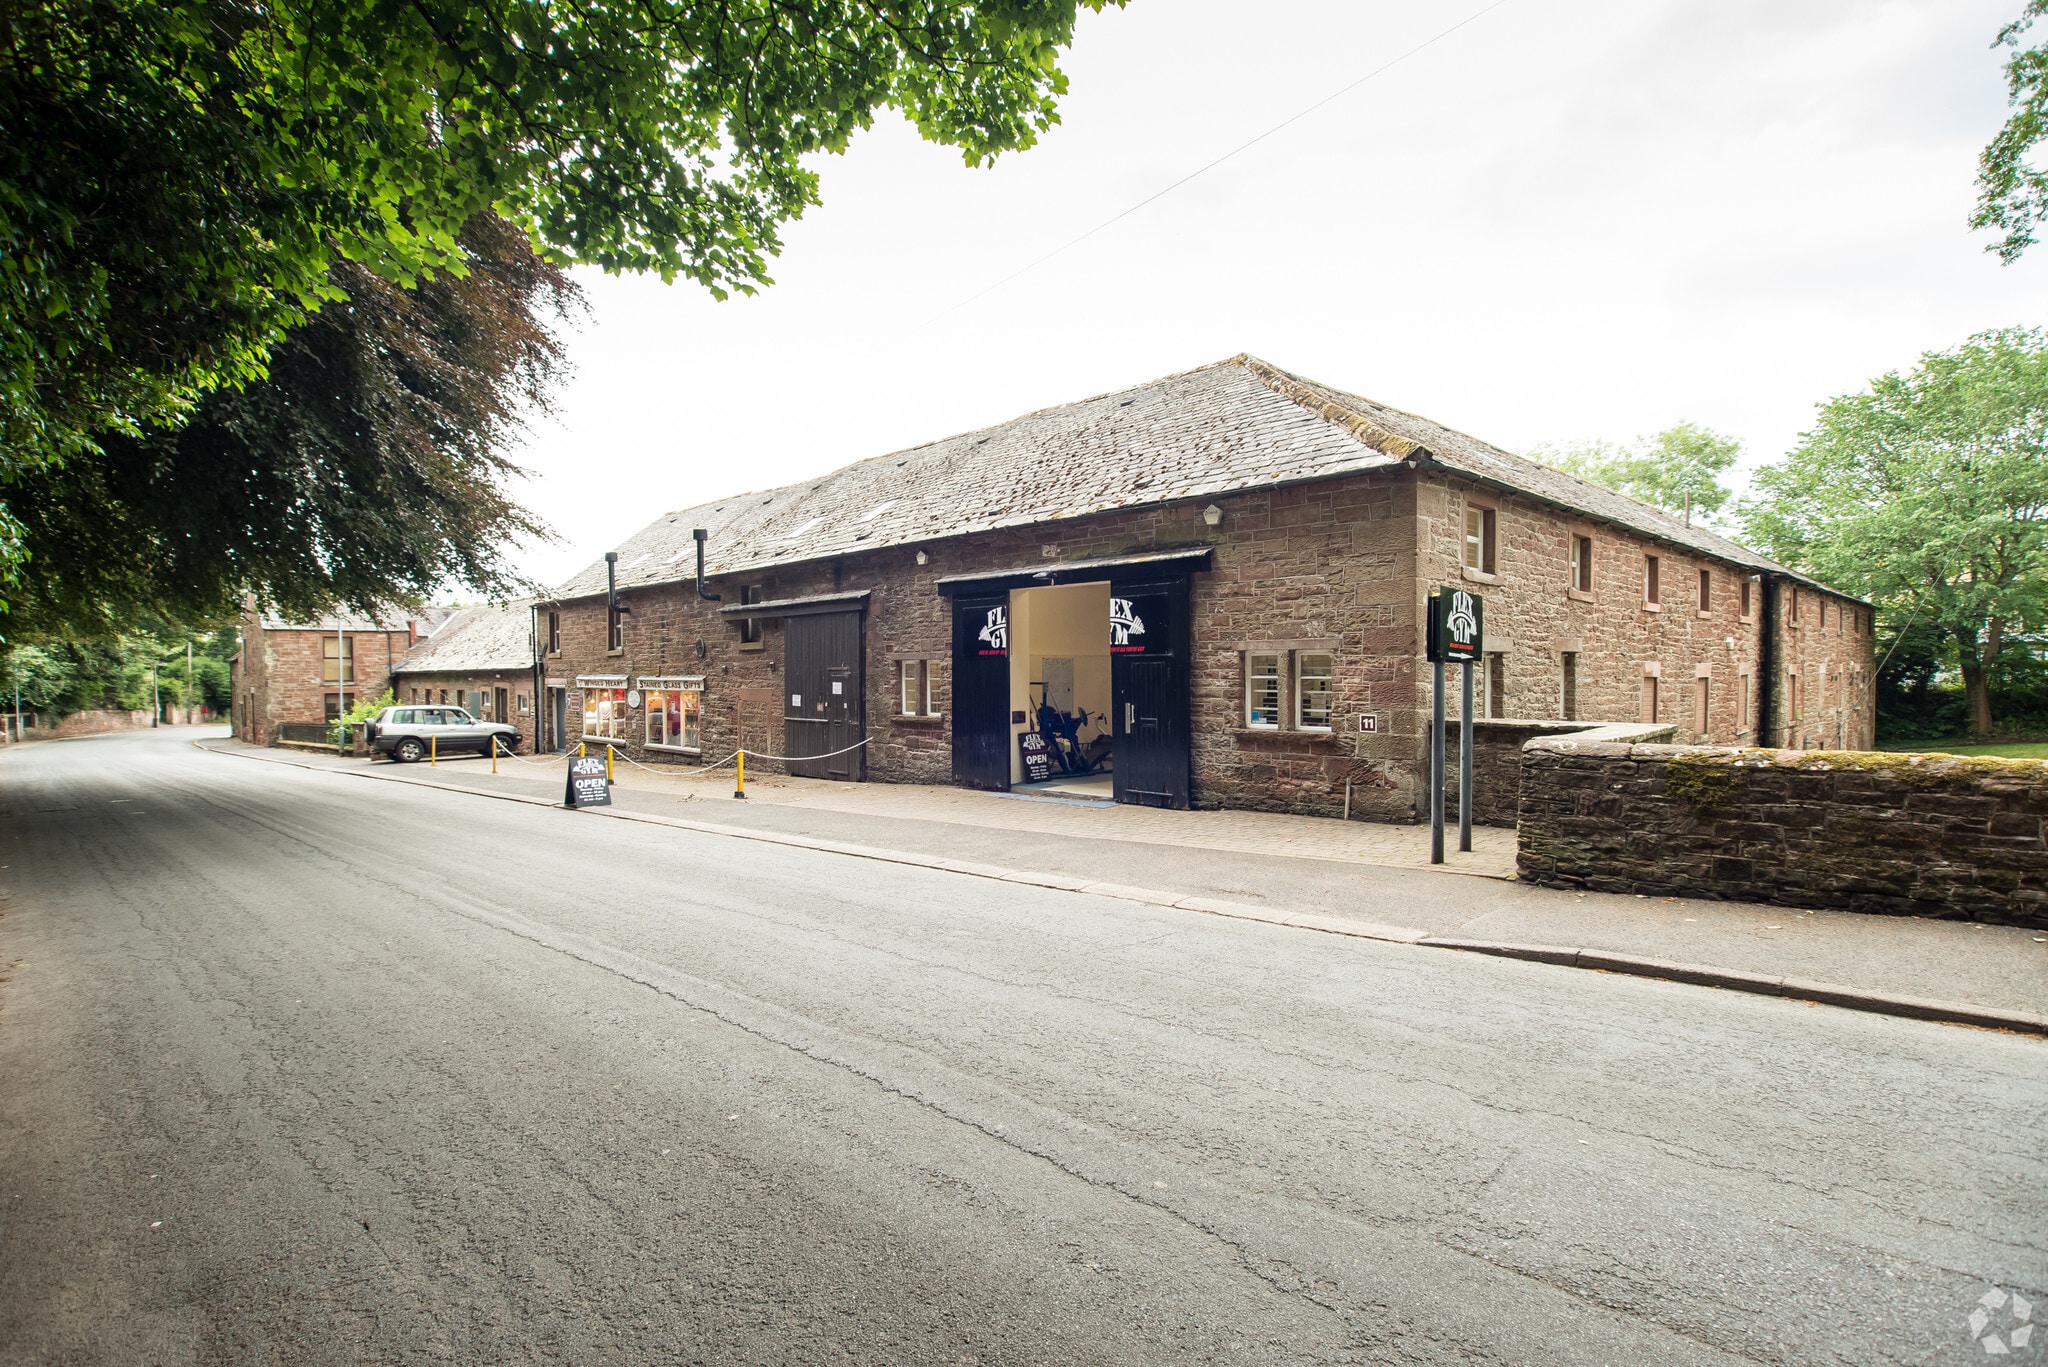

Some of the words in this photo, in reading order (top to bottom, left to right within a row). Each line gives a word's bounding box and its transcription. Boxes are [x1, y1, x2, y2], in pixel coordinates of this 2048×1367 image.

[1452, 591, 1474, 620] FLEX
[1454, 617, 1470, 644] GYM
[639, 680, 661, 688] STAINED
[663, 681, 681, 689] GLASS
[683, 681, 701, 689] GIFTS
[1363, 718, 1374, 729] 11
[1025, 734, 1041, 742] FLEX
[577, 758, 599, 768] FLEX
[1026, 754, 1047, 765] OPEN
[575, 778, 606, 789] OPEN
